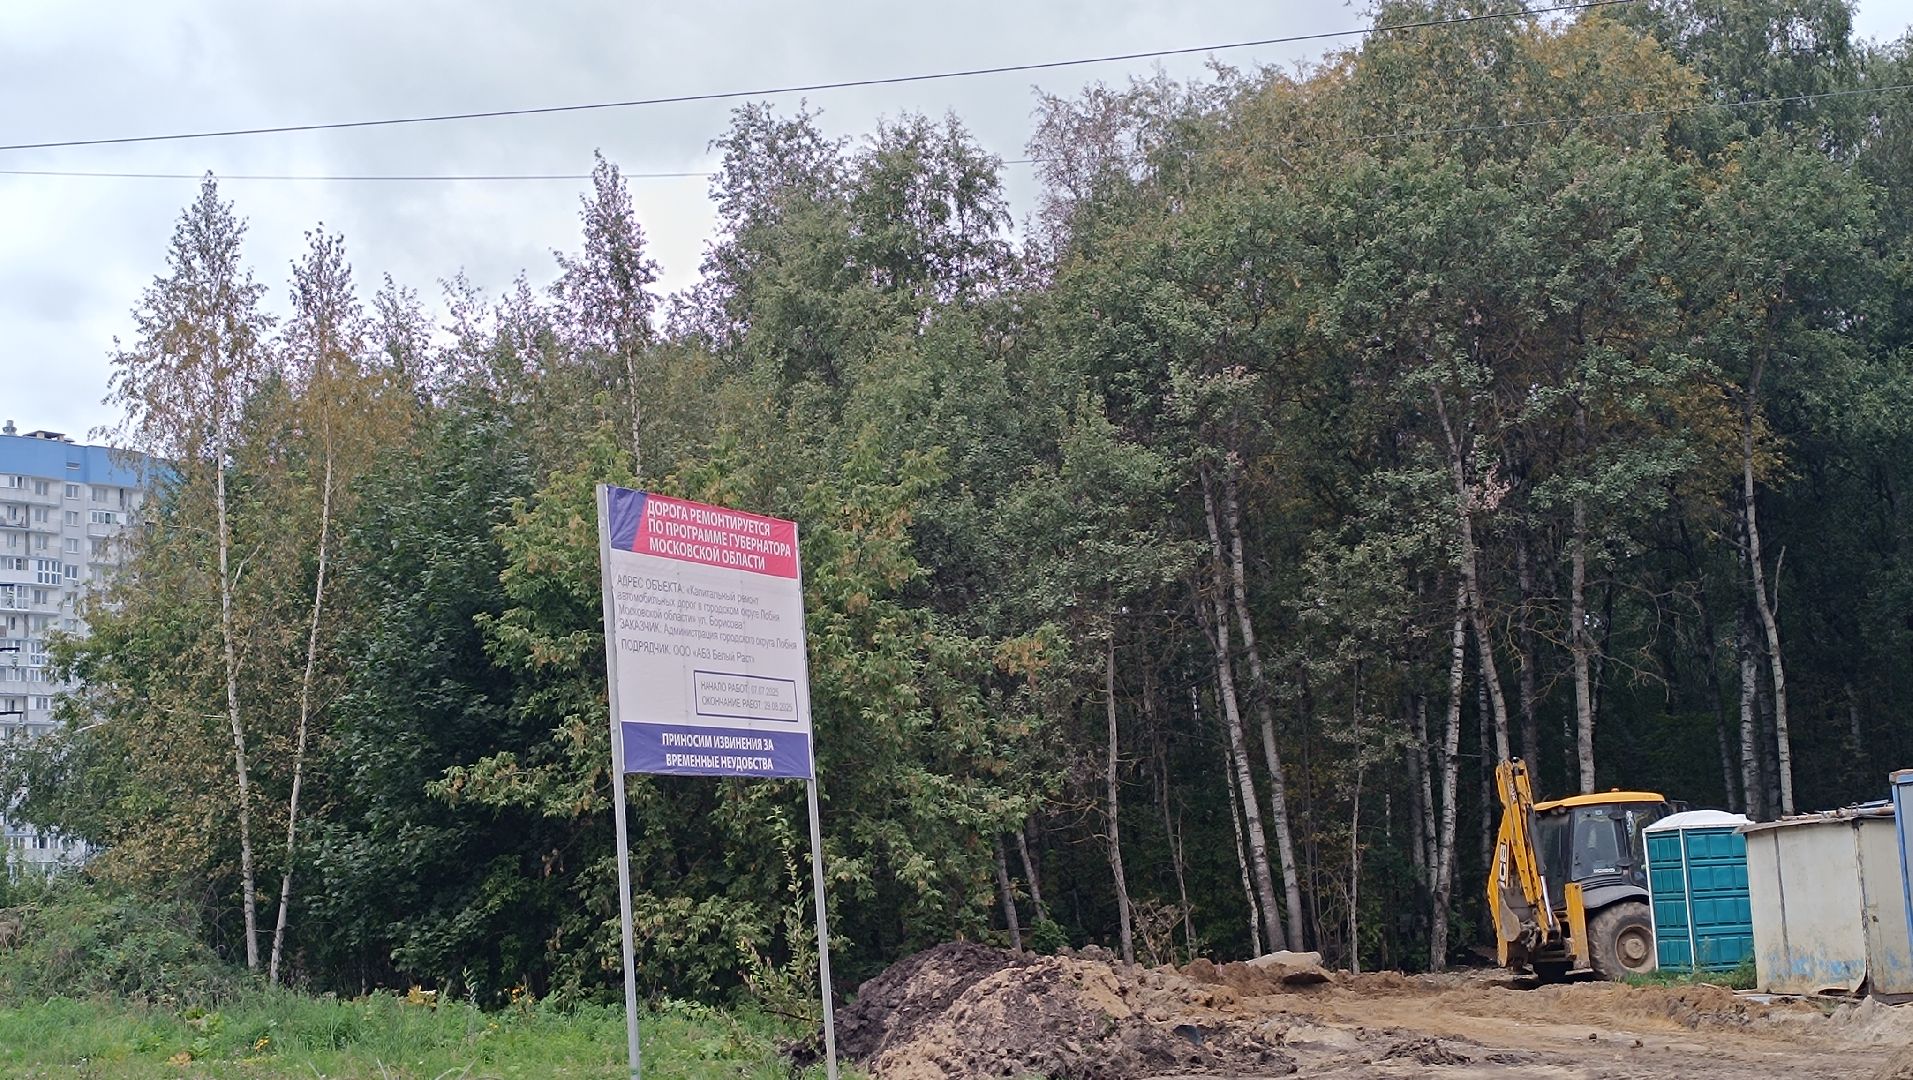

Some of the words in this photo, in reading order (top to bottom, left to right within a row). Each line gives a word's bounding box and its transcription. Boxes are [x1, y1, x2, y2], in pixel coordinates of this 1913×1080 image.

[647, 500, 688, 521] ДОРОГА
[690, 508, 770, 536] РЕМОНТИРУЕТСЯ
[648, 518, 664, 534] ПО
[666, 522, 728, 546] ПРОГРАММЕ
[729, 531, 792, 557] ГУБЕРНАТОРА
[649, 537, 720, 561] МОСКОВСКОЙ
[722, 550, 766, 570] ОБЛАСТИ
[617, 575, 643, 589] АДРЕС
[737, 594, 759, 605] ремонт
[617, 591, 676, 607] автомобильных
[677, 600, 697, 611] дорог
[703, 603, 739, 616] городском
[618, 604, 663, 619] Московской
[664, 623, 719, 641] Администрация
[673, 644, 692, 657] ООО
[712, 647, 735, 661] Белый
[700, 680, 727, 692] НАЧАЛО
[701, 696, 741, 708] ОКОНЧАНИЕ
[662, 733, 712, 749] ПРИНОСИМ
[713, 735, 763, 750] ИЗВИНЕНИЯ
[763, 738, 774, 751] ЗА
[665, 753, 720, 768] ВРЕМЕННЫЕ
[721, 756, 774, 771] НЕУДОБСТВА
